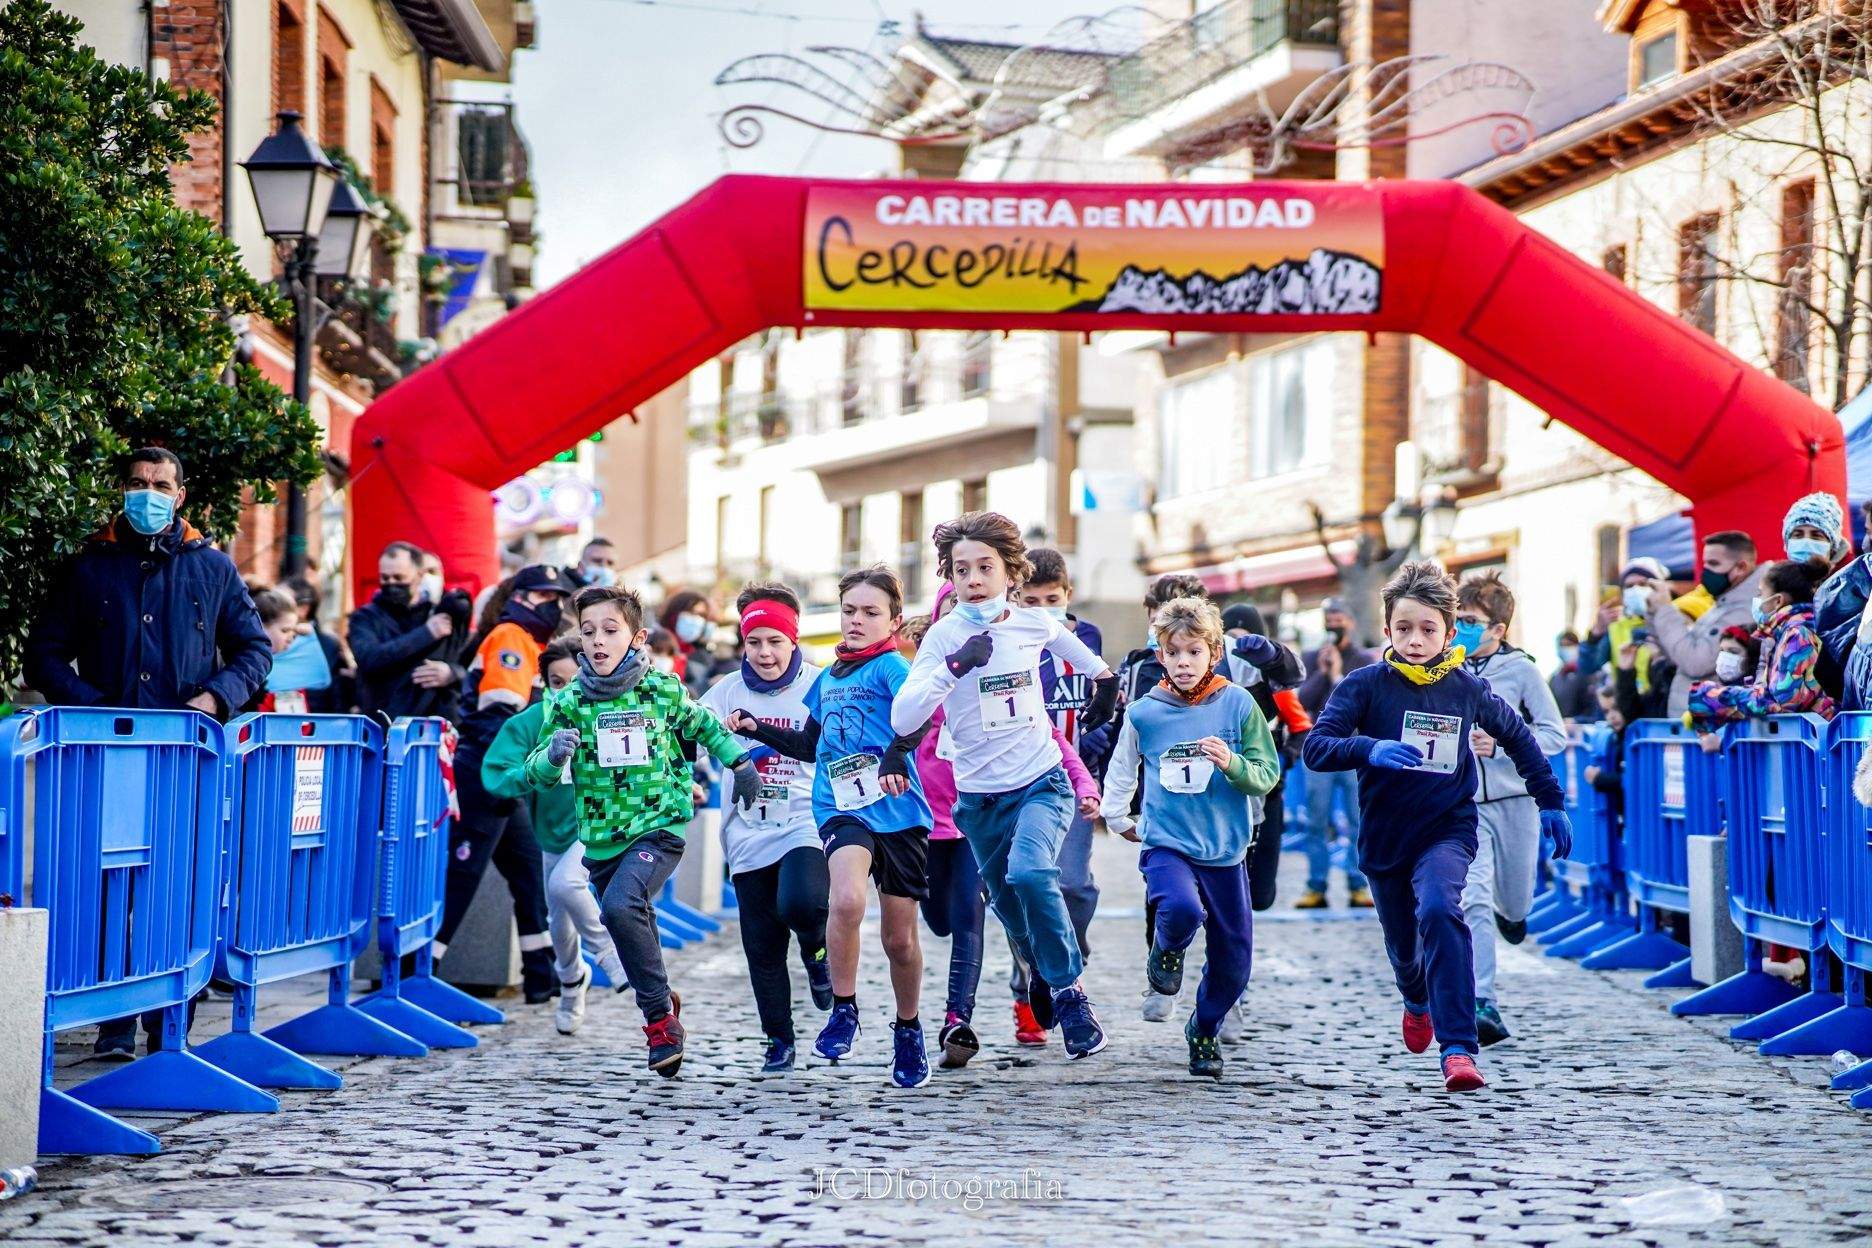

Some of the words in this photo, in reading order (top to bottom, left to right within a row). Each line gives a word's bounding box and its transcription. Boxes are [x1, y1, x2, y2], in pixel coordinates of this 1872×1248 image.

[876, 196, 1077, 228] CARRERA
[1083, 207, 1122, 228] DE
[1126, 198, 1315, 229] NAVIDAD
[1005, 697, 1015, 717] 1
[621, 734, 630, 755] 1
[1426, 739, 1436, 760] 1
[767, 756, 801, 766] Madrid
[1181, 765, 1191, 784] 1
[853, 777, 866, 797] 1
[758, 804, 767, 820] 1
